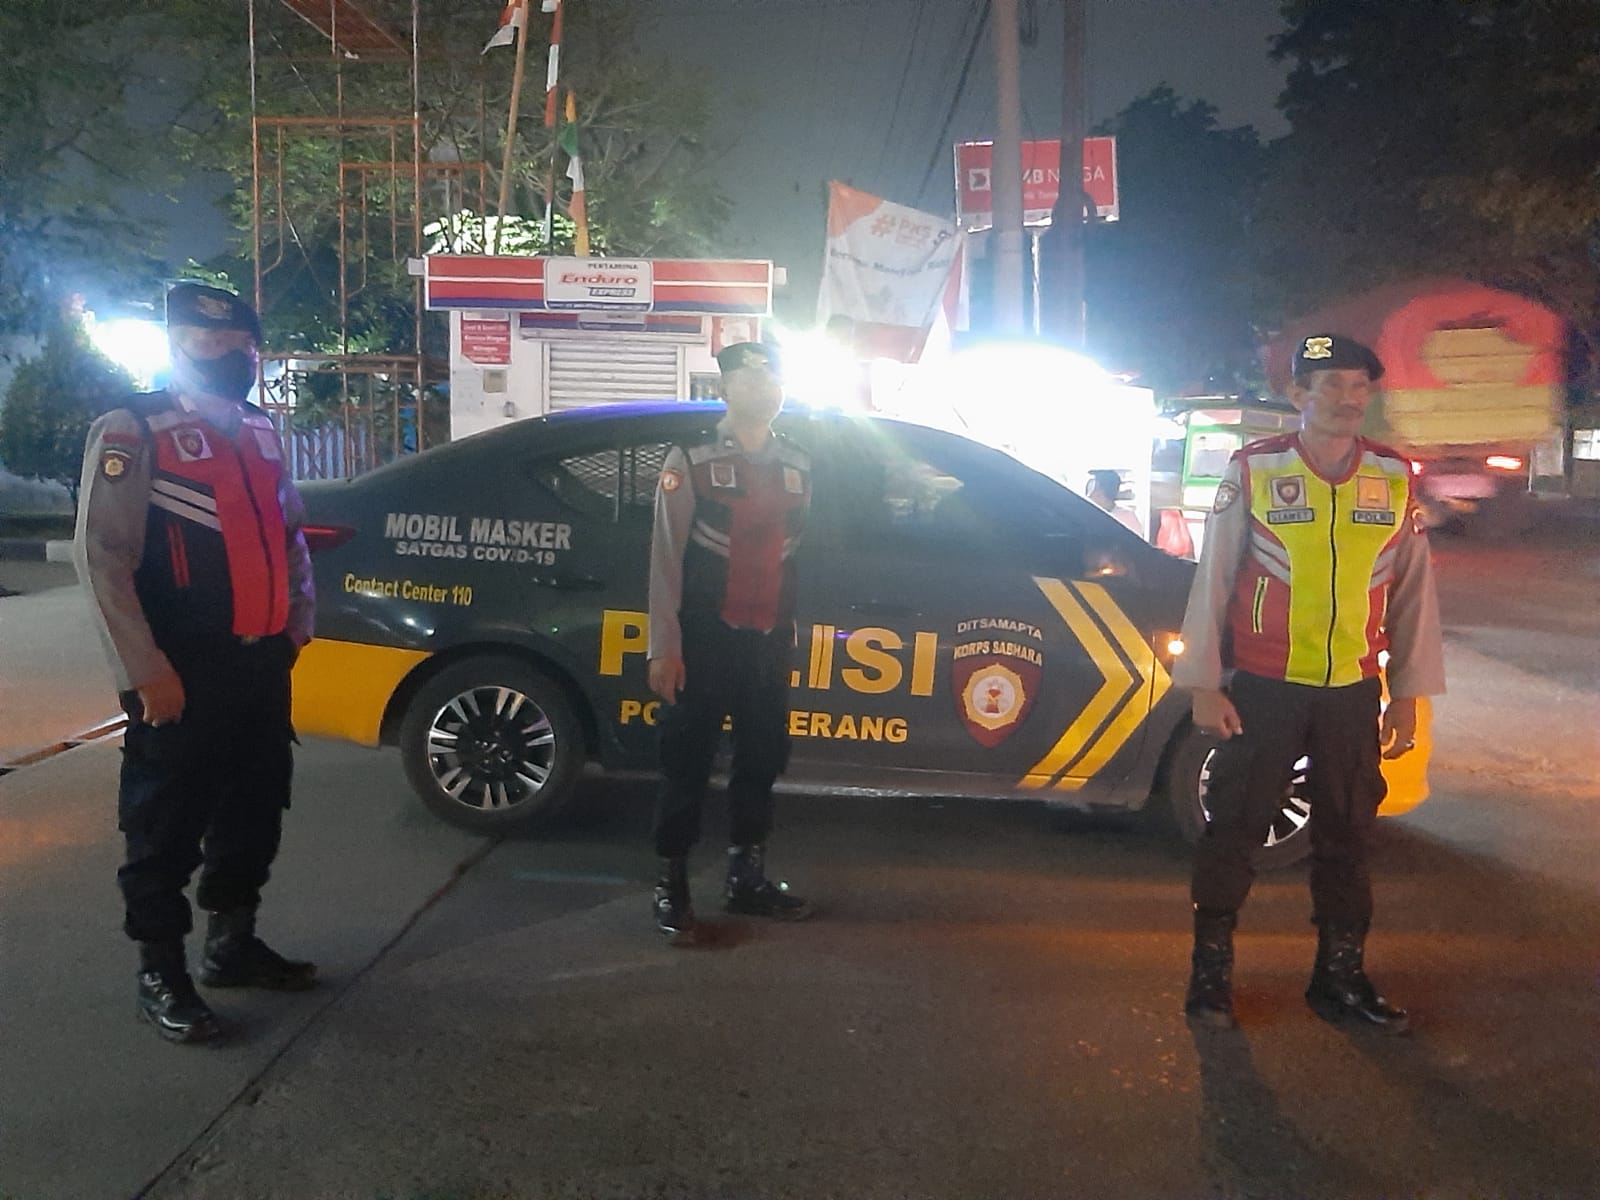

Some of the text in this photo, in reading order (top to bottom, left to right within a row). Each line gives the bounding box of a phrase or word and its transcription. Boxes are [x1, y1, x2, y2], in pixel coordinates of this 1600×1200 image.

[560, 272, 638, 284] Enduro
[385, 512, 572, 550] MOBIL MASKER
[395, 540, 468, 560] SATGAS
[344, 573, 473, 606] Contact Center 110
[956, 617, 1043, 641] DITSAMAPTA
[953, 640, 1043, 667] KORPS SABHARA
